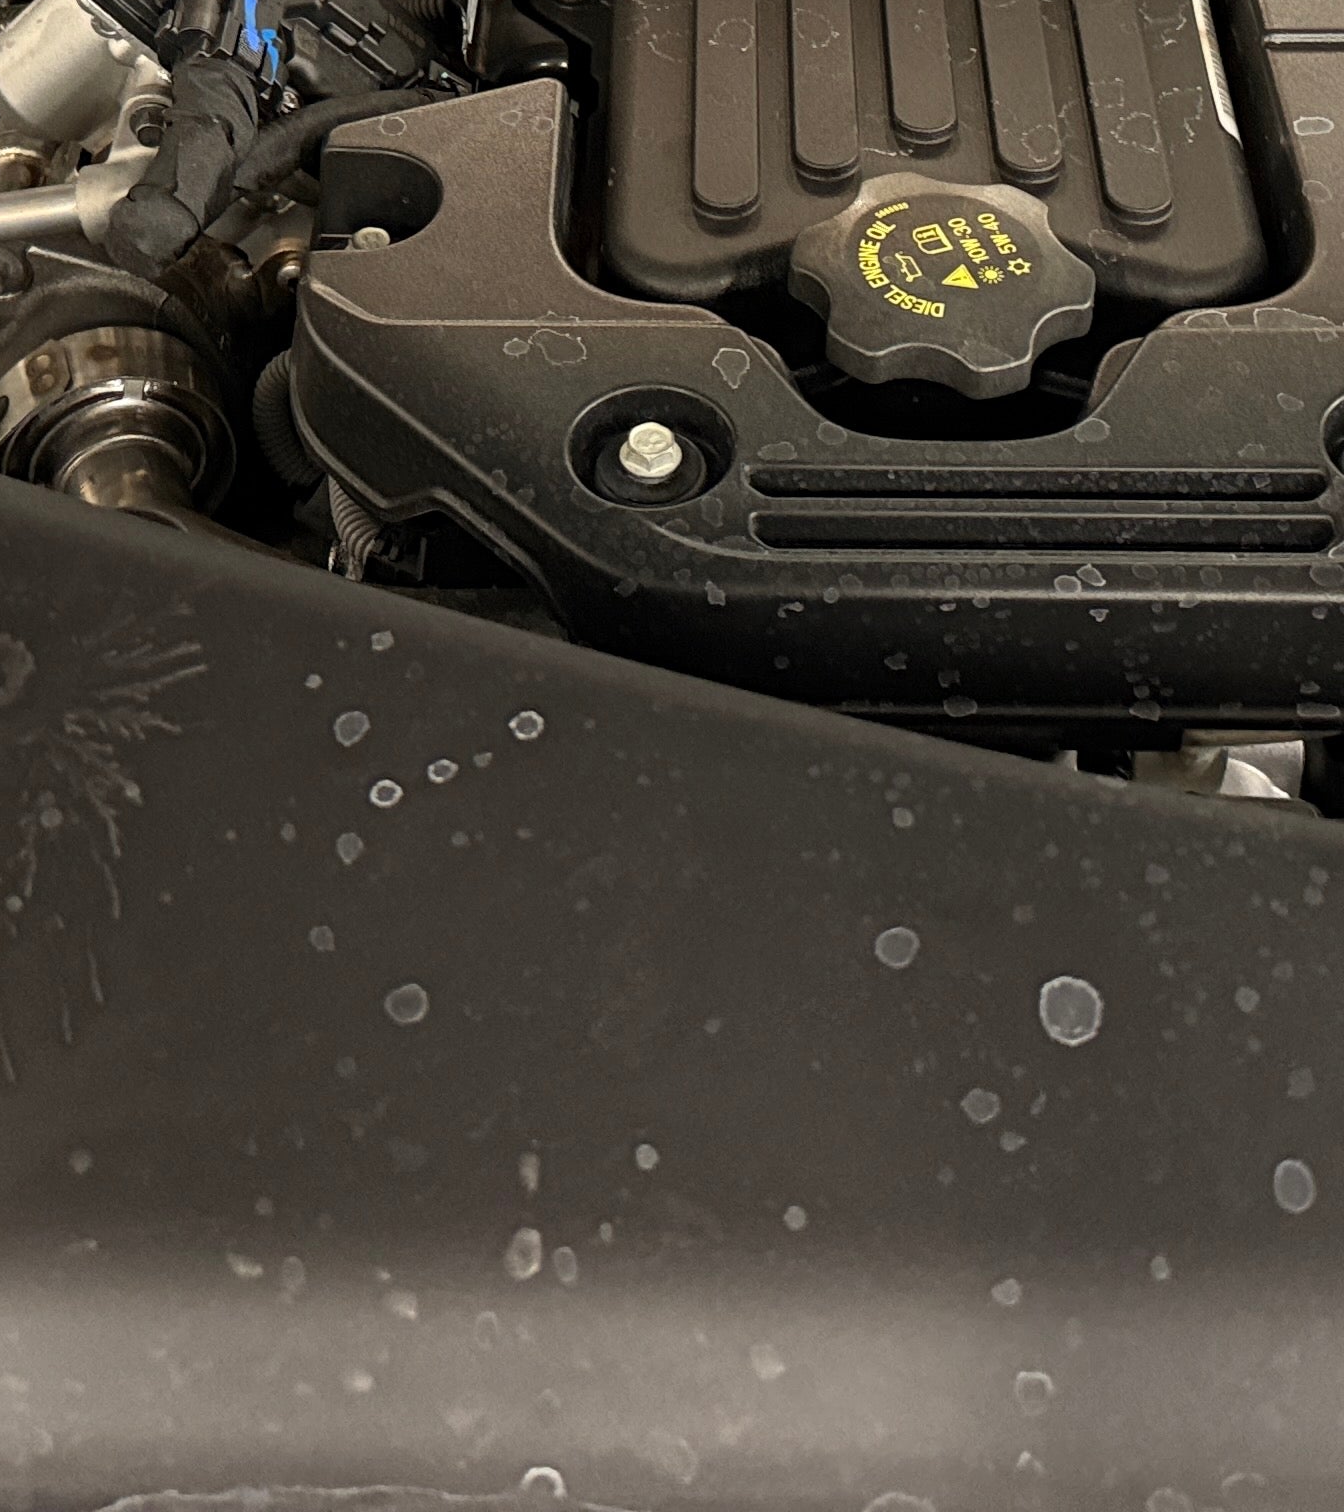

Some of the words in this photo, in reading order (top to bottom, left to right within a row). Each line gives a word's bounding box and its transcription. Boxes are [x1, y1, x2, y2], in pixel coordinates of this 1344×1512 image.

[864, 219, 898, 241] OIL
[946, 216, 991, 265] 10W-30
[976, 212, 1018, 256] 5W-40
[857, 238, 891, 290] ENGINE
[882, 284, 946, 319] DIESEL
